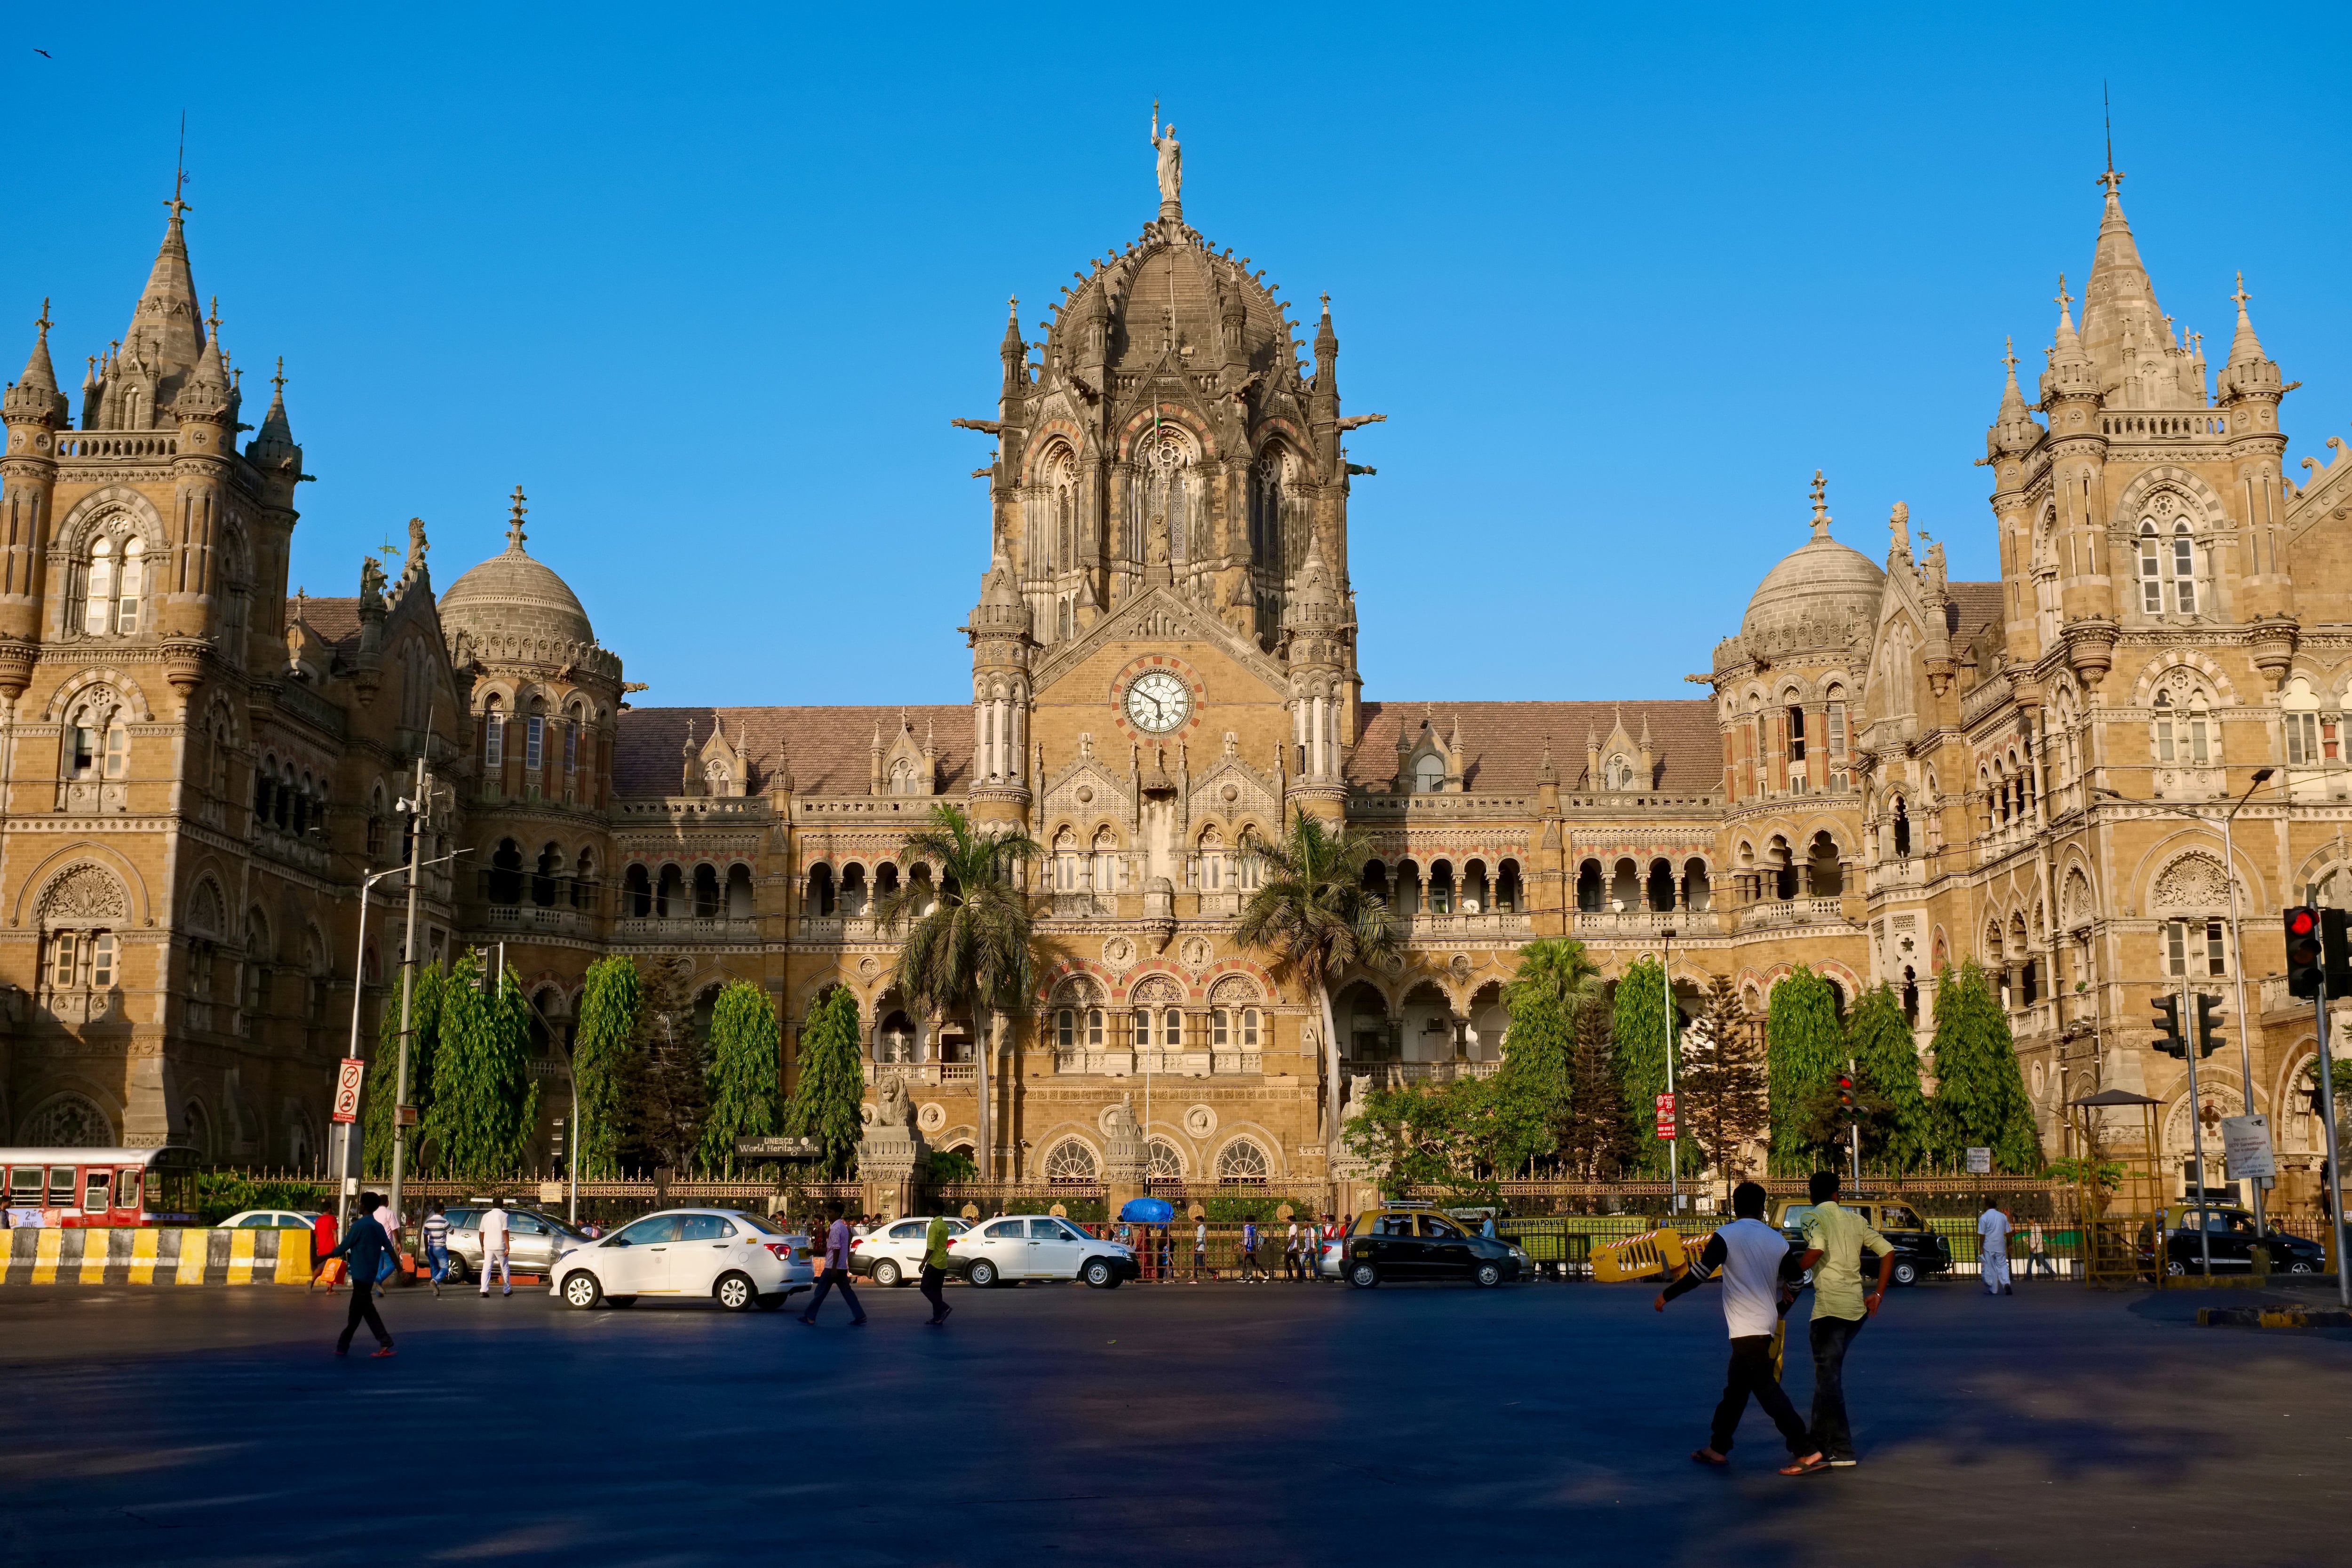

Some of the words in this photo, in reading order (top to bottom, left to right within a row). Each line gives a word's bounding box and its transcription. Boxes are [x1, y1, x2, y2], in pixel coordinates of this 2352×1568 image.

[739, 1144, 764, 1152] World
[767, 1144, 801, 1156] Heritage
[25, 1211, 36, 1220] 2nd
